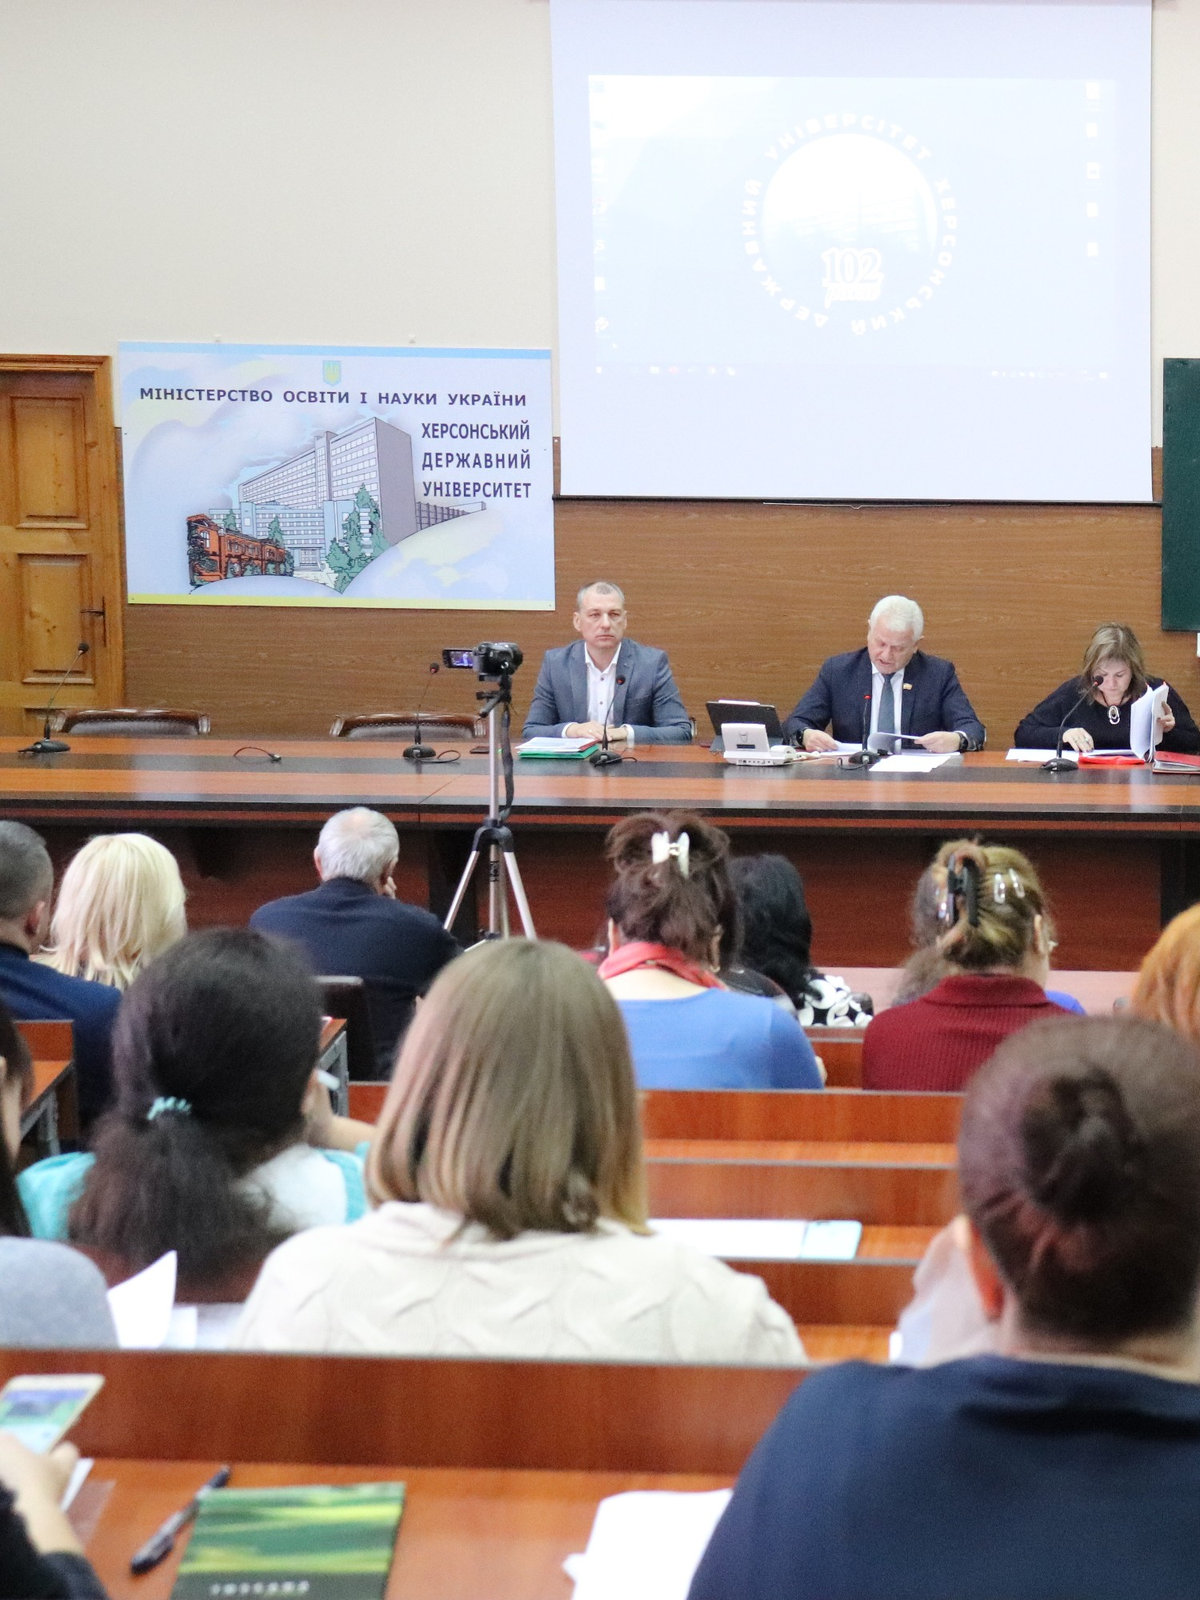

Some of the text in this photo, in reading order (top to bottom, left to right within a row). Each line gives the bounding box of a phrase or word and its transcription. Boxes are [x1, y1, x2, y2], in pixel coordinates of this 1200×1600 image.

[140, 387, 527, 406] МІНІСТЕРСТВО ОСВІТИ І НАУКИ УКРАЇНИ
[421, 420, 531, 440] ХЕРСОНСЬКИЙ
[422, 449, 532, 471] ДЕРЖАВНИЙ
[423, 481, 532, 498] УНІВЕРСИТЕТ
